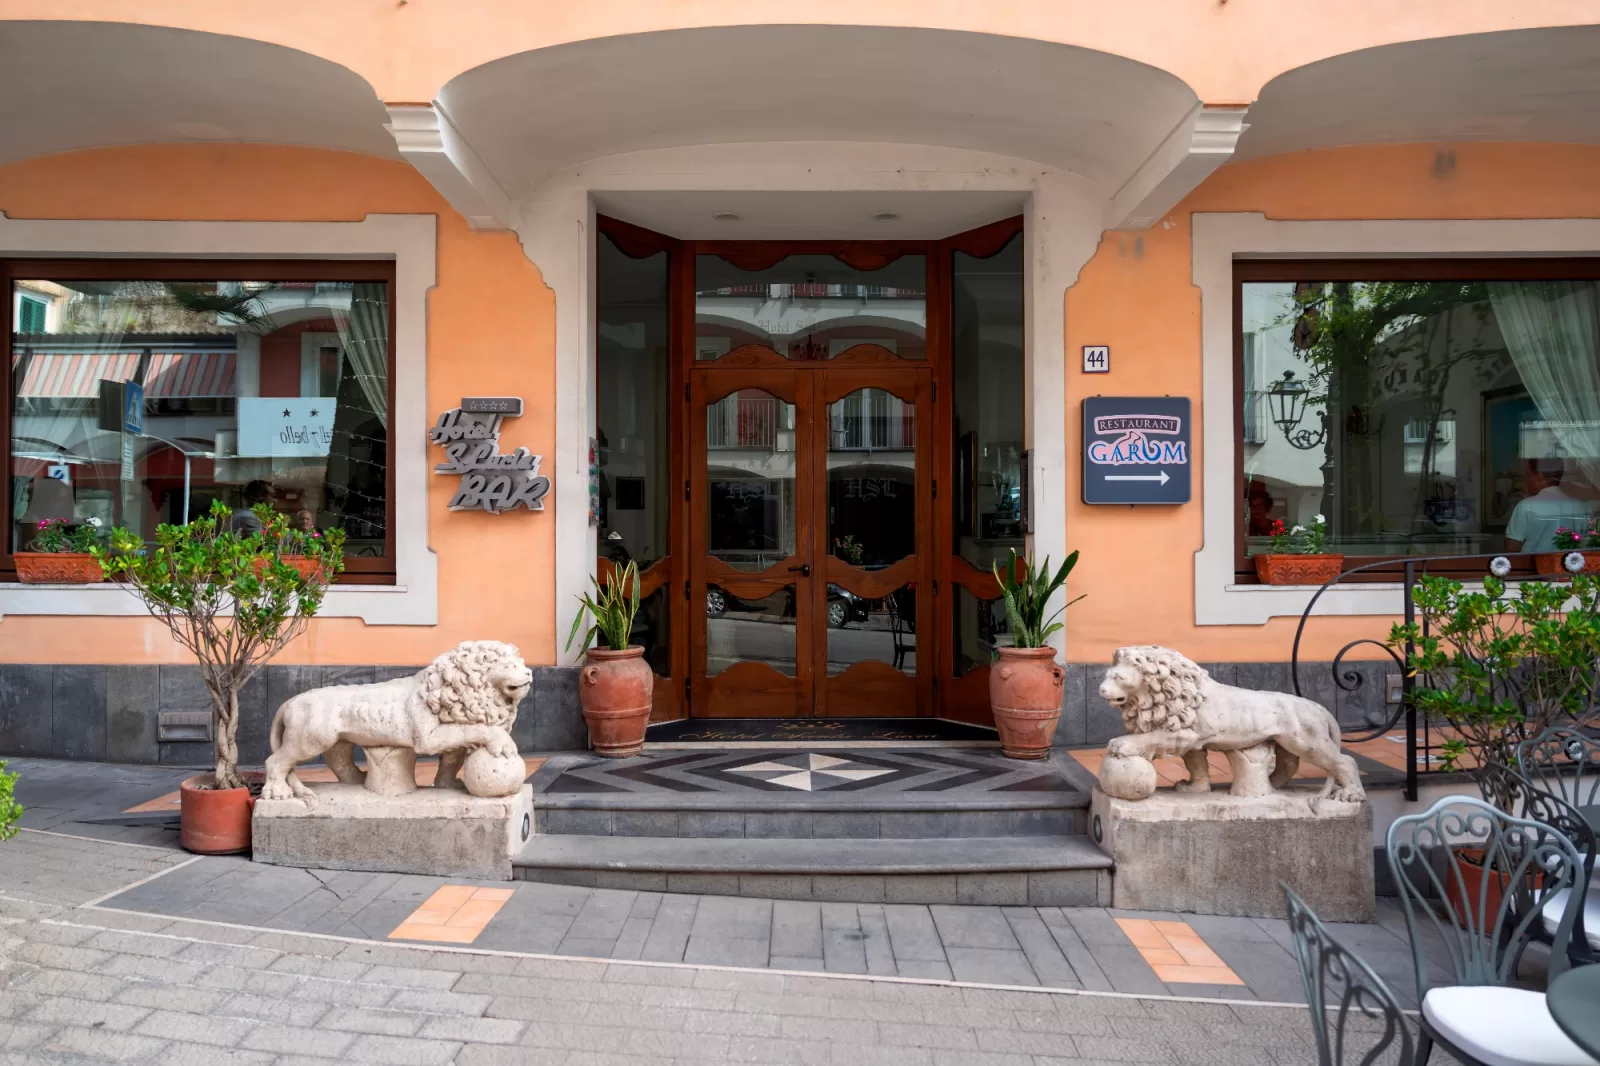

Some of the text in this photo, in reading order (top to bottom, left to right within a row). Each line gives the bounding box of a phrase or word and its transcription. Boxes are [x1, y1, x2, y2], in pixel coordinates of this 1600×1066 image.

[1087, 350, 1105, 368] 44
[429, 409, 499, 444] Hotel
[1099, 418, 1176, 431] RESTAURANT
[447, 474, 551, 511] BAR
